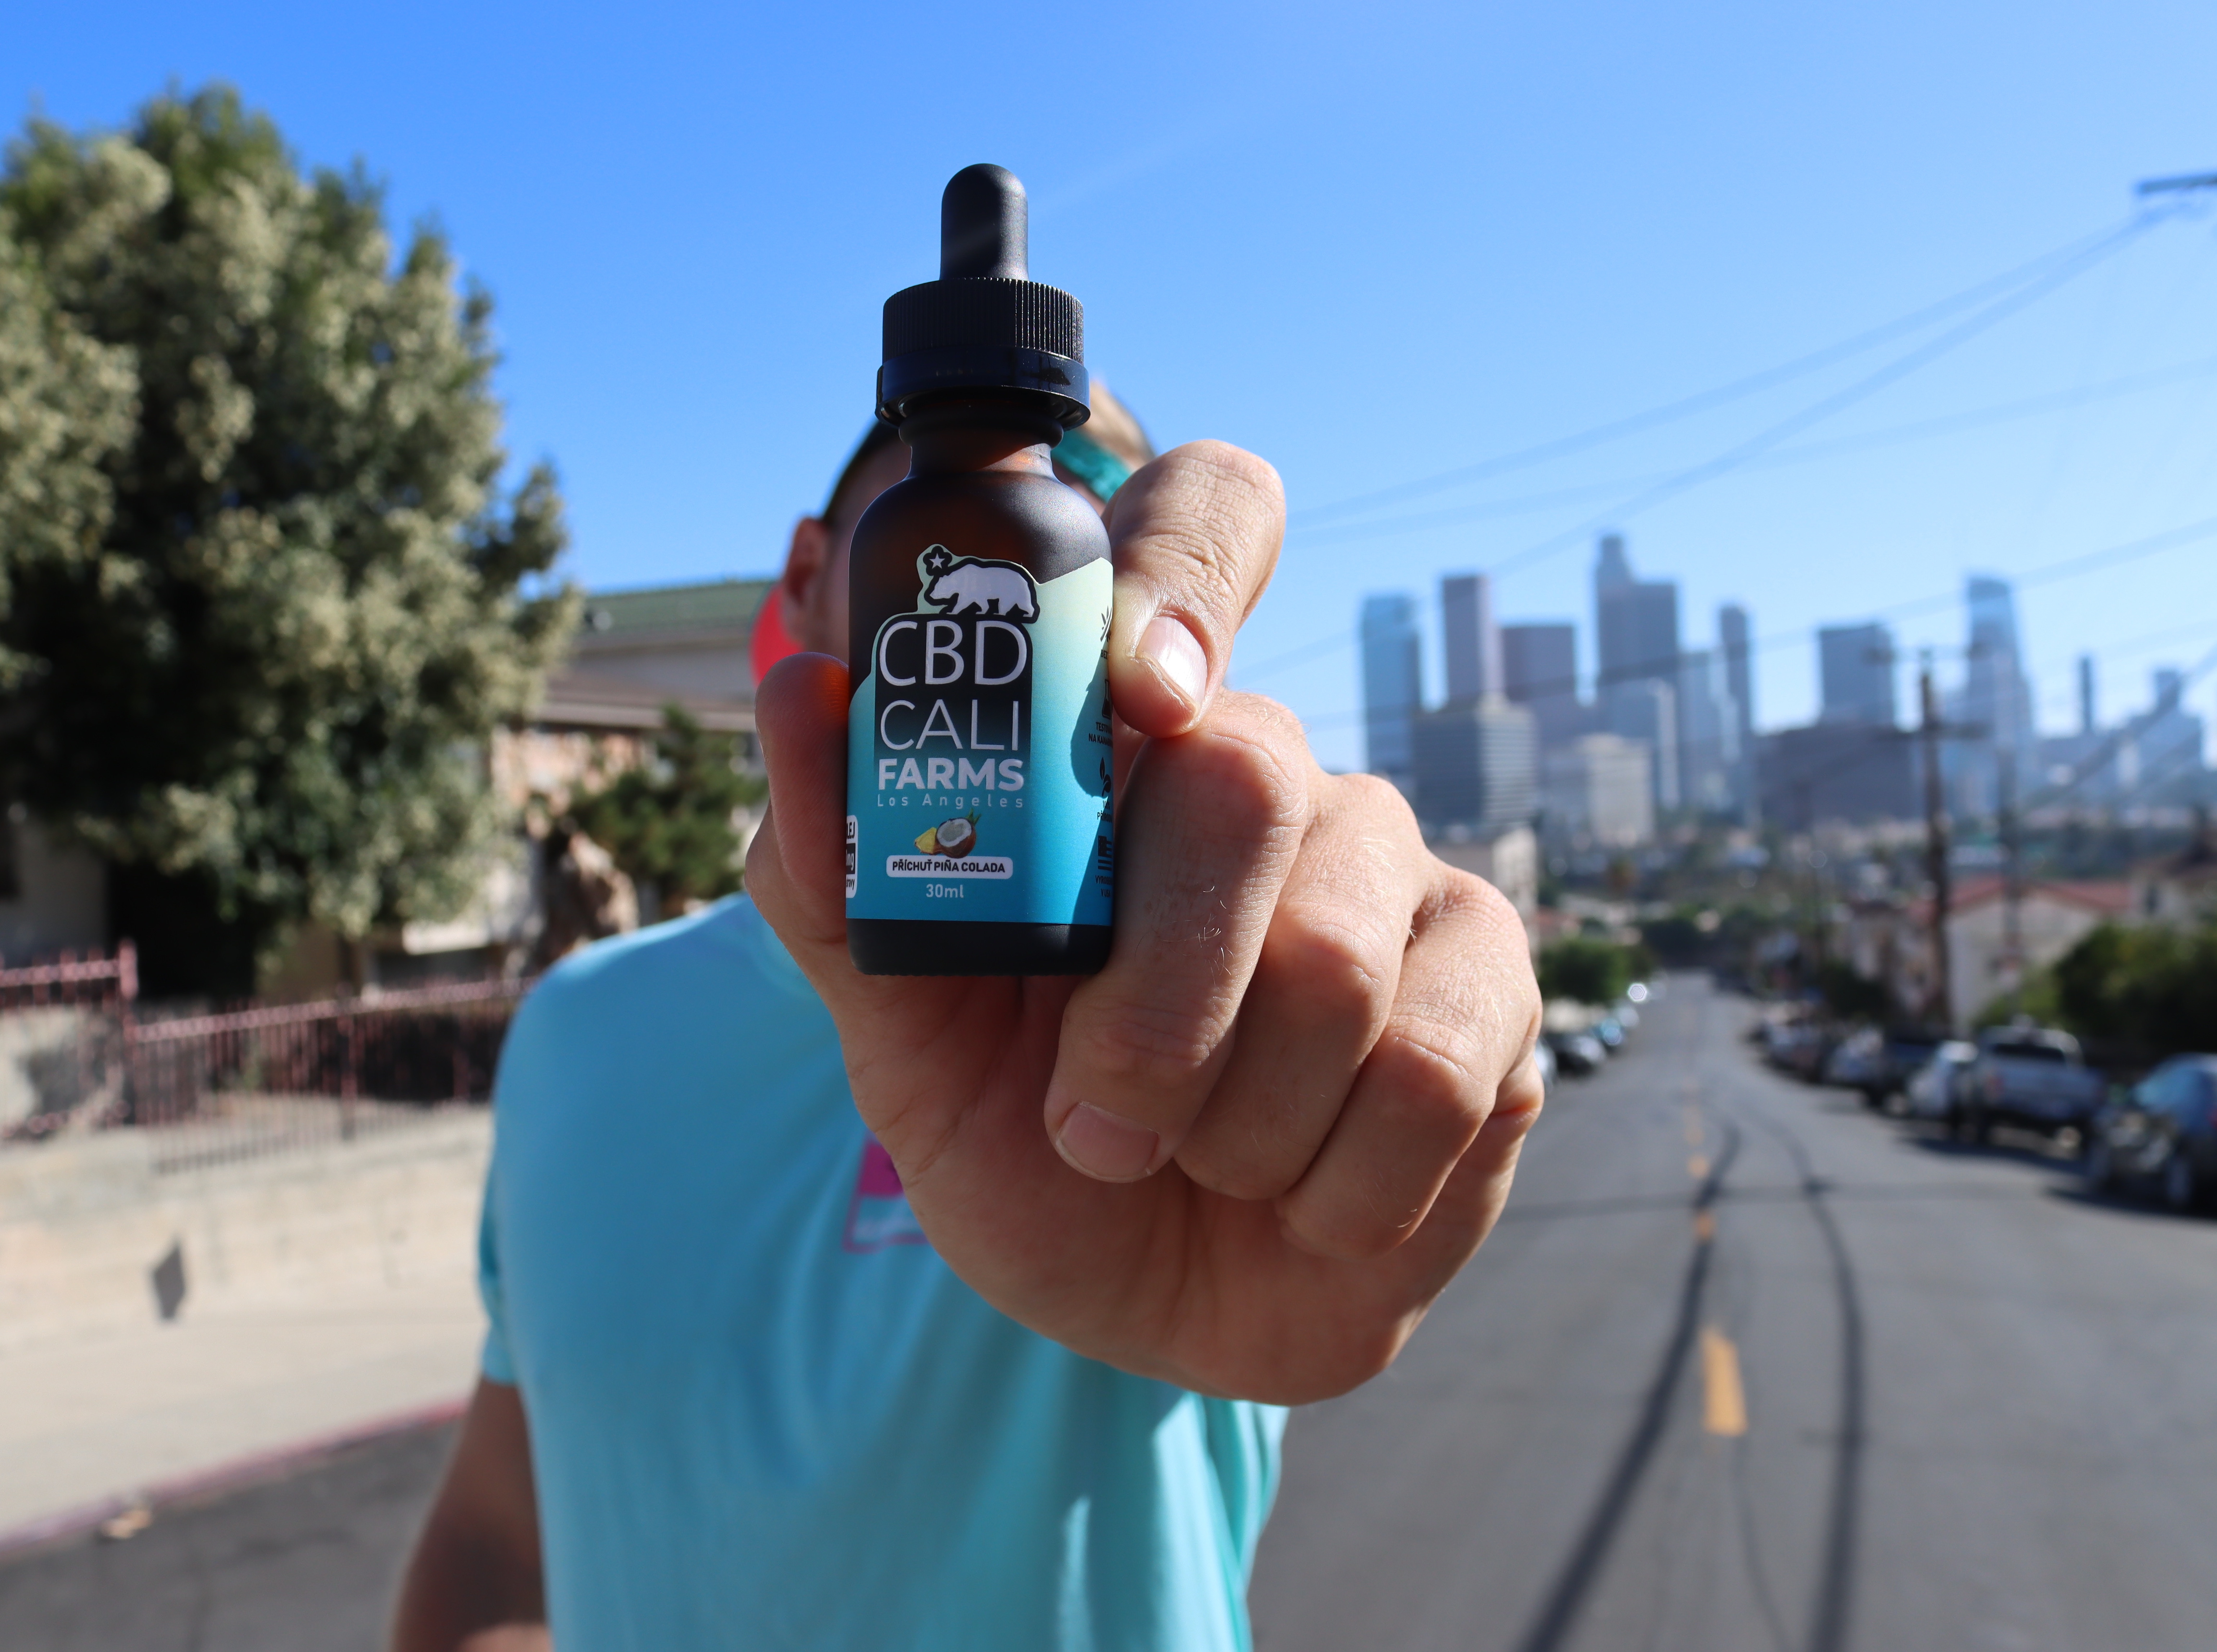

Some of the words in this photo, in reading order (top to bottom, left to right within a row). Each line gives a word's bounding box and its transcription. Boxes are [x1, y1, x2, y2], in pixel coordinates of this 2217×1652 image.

[879, 620, 1027, 686] CBD
[880, 699, 1019, 751] CALI
[1089, 733, 1096, 743] NA
[878, 757, 1025, 791] FARMS
[877, 794, 908, 807] Los
[921, 793, 1023, 810] Angeles
[892, 858, 932, 871] PŘÍCHUŤ
[934, 859, 959, 872] PIÑA
[961, 862, 1005, 873] COLADA
[926, 883, 964, 898] 30ml
